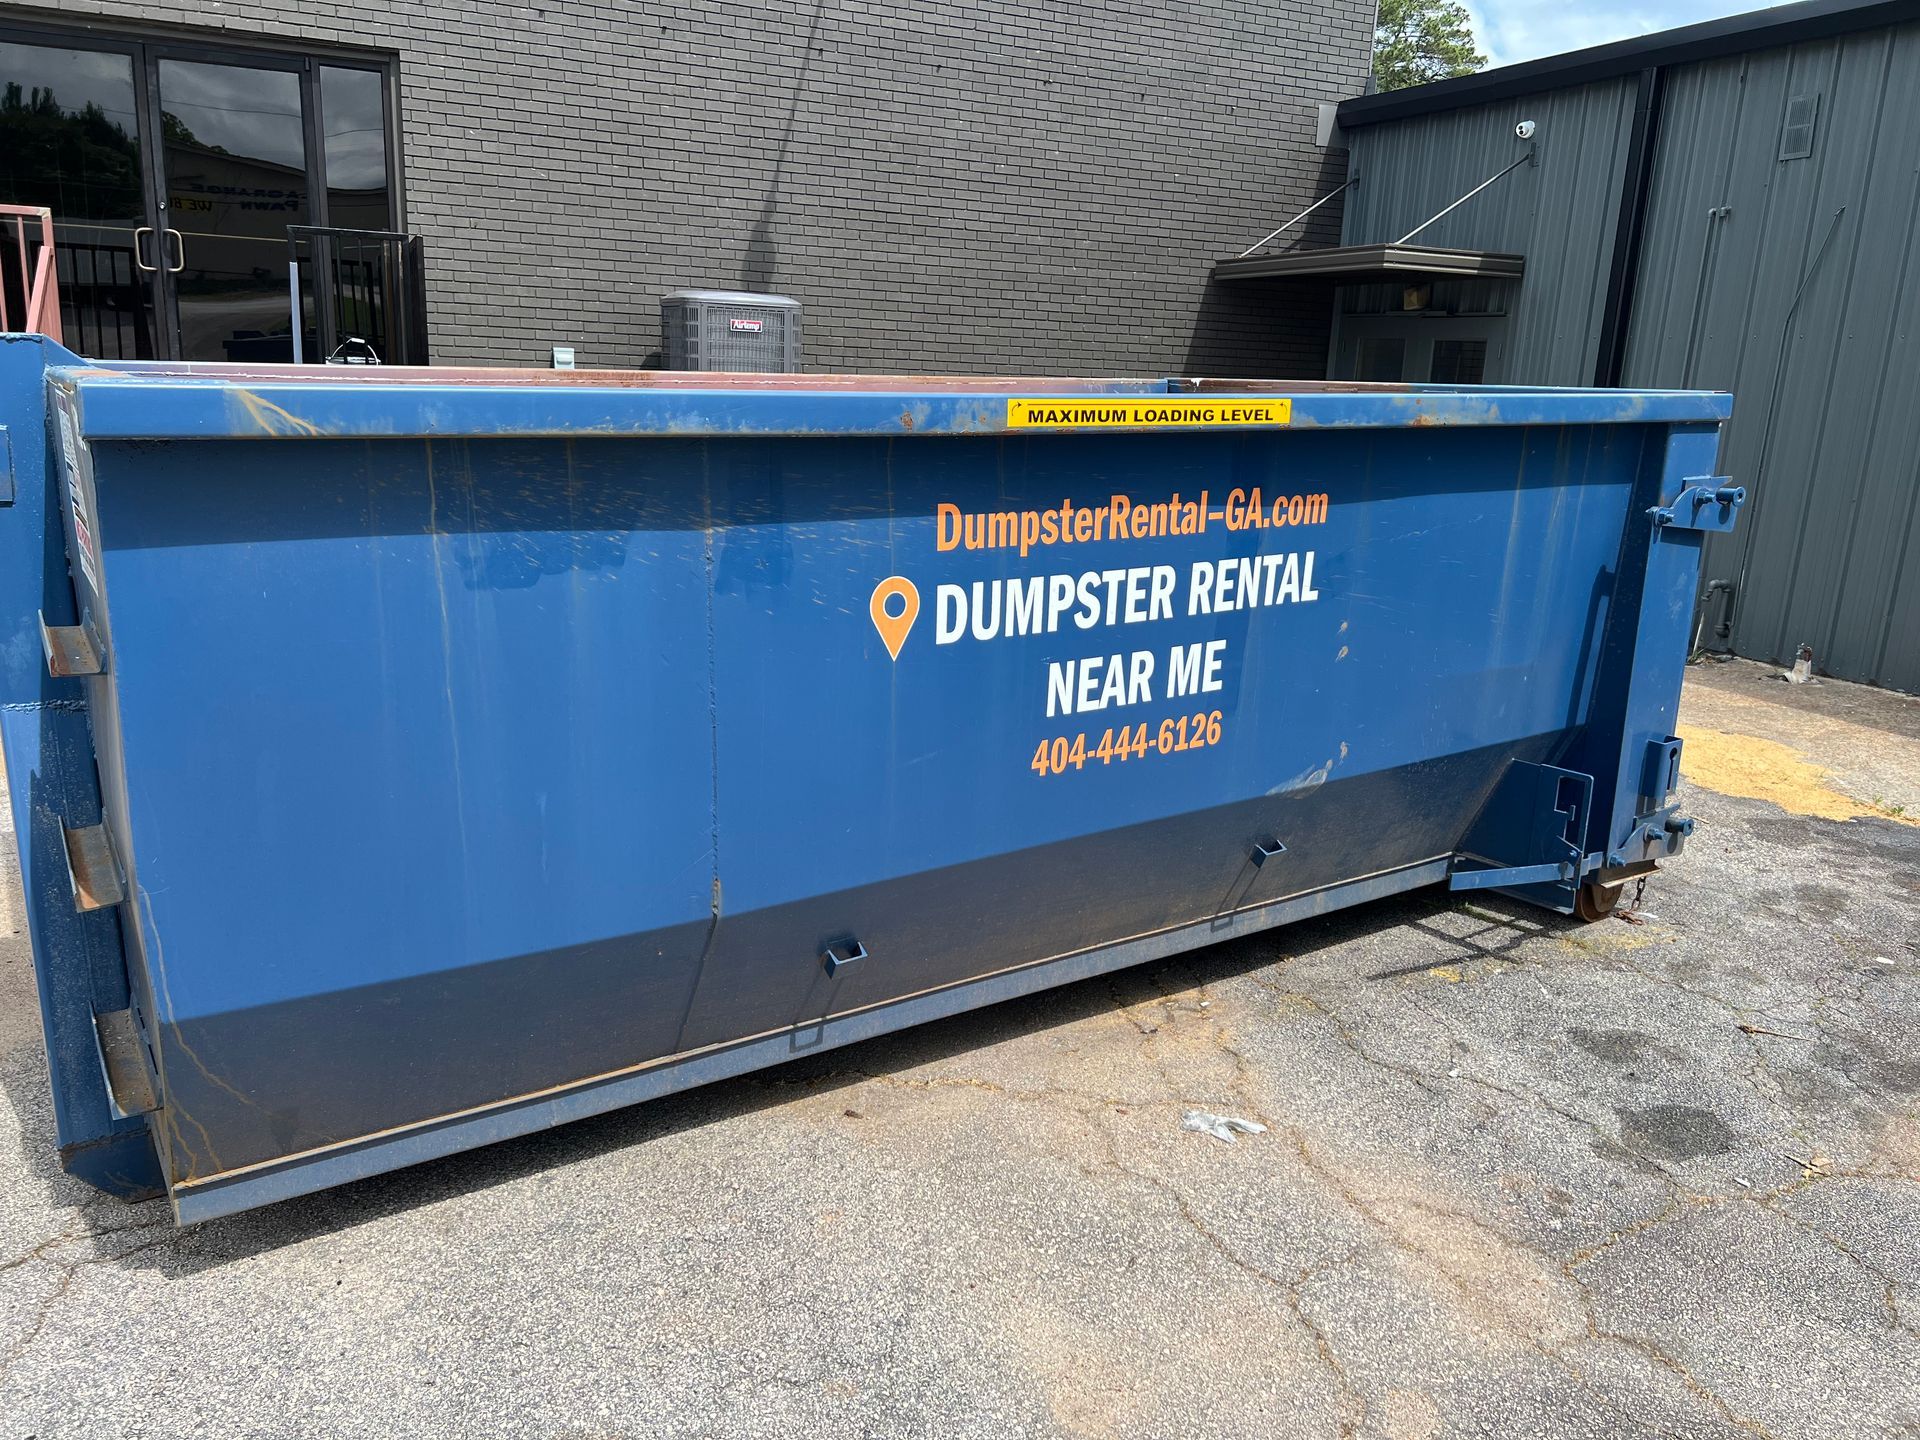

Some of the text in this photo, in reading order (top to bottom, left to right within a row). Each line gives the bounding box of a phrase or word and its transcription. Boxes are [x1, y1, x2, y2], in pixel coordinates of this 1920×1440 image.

[733, 320, 760, 331] Airtemp
[1028, 408, 1274, 423] MAXIMUM LOADING LEVEL
[937, 488, 1328, 556] DumpsterRental-GA.com
[935, 551, 1319, 645] DUMPSTER RENTAL
[1046, 640, 1227, 717] NEAR ME
[1031, 711, 1223, 776] 404-444-6126
